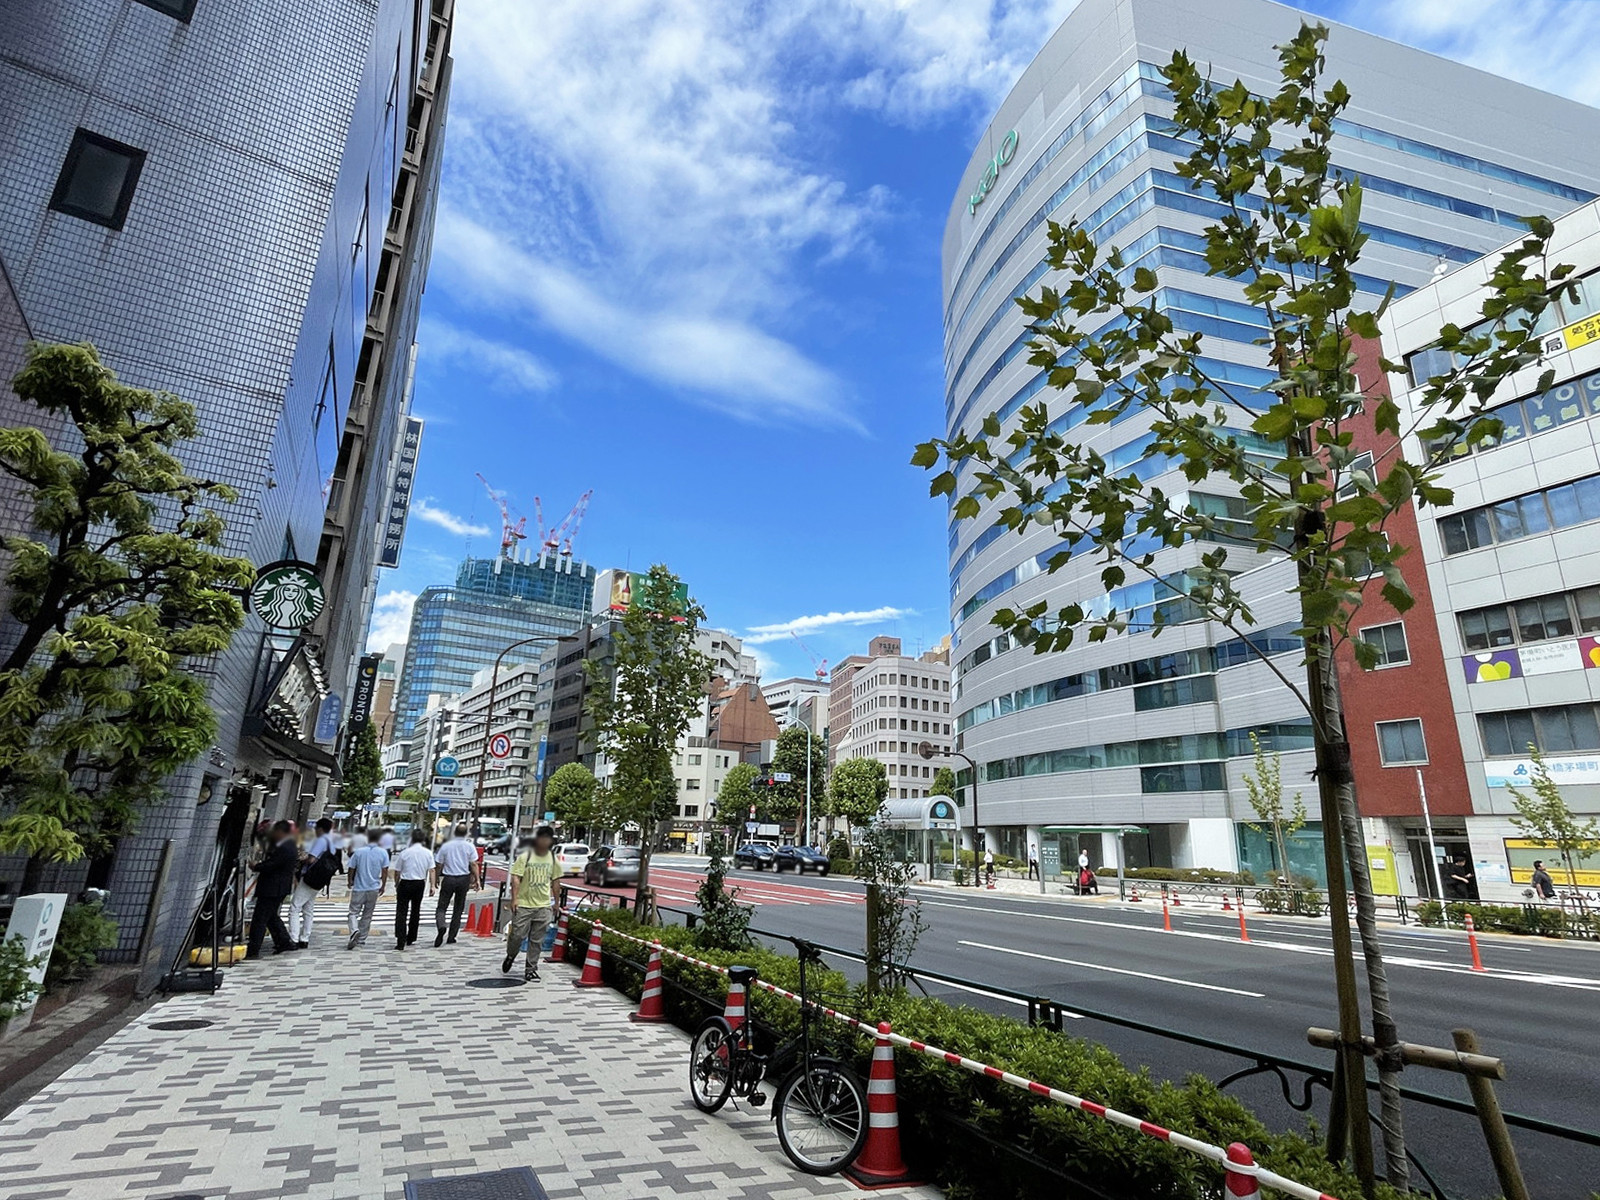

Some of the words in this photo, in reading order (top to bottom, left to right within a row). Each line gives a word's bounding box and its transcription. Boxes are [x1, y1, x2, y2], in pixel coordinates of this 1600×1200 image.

[967, 128, 1019, 216] kao
[1541, 337, 1562, 355] 局
[1586, 327, 1600, 340] 受
[384, 431, 419, 551] 林国際特許事務所
[354, 680, 370, 722] PRONTO
[1529, 761, 1599, 775] 日橋茅場町
